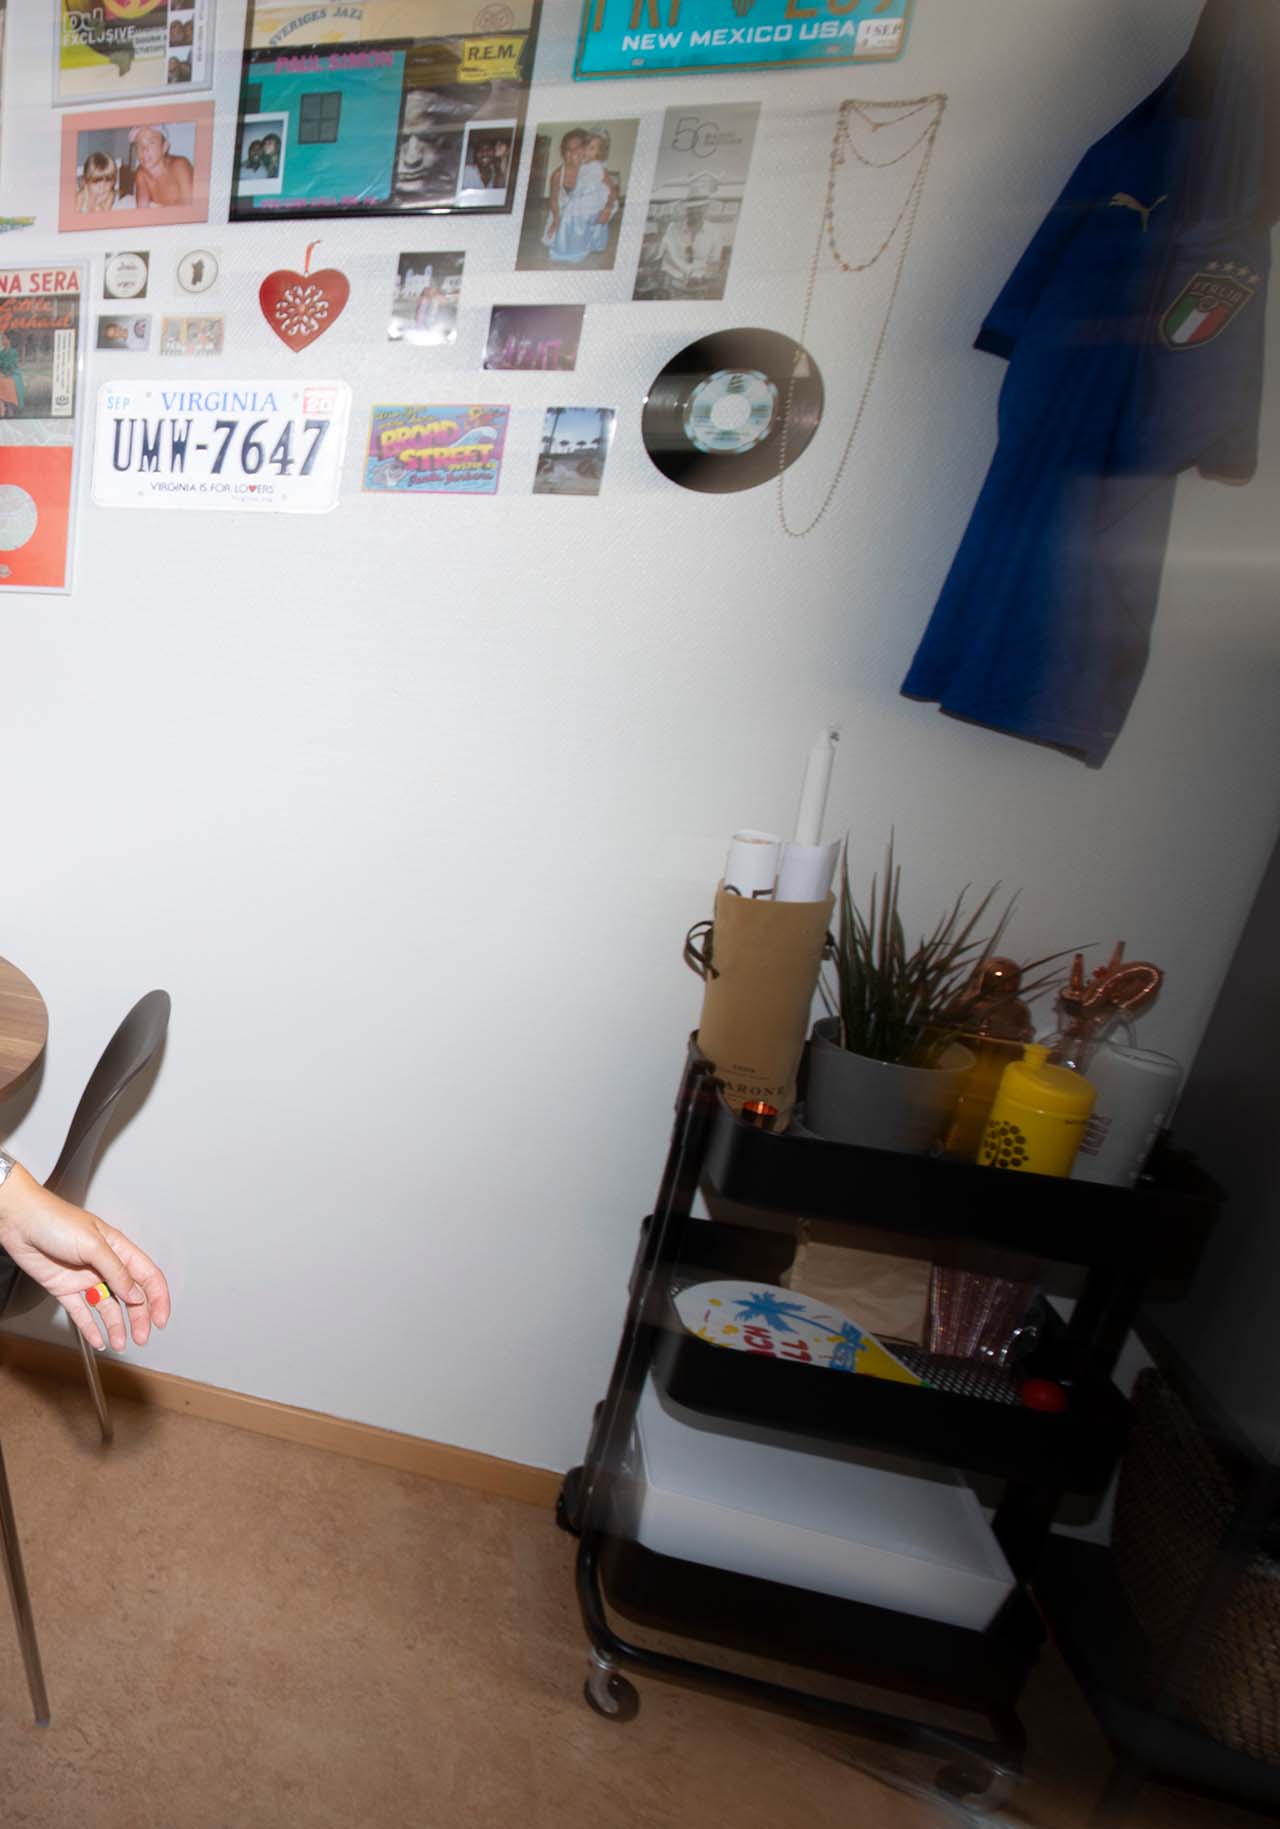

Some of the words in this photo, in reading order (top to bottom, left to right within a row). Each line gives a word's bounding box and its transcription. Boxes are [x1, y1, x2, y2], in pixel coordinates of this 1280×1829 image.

[621, 32, 684, 51] NEW
[689, 24, 793, 48] MEXICO
[798, 19, 856, 41] USA
[467, 43, 517, 61] R.E.M.
[29, 271, 79, 294] SERA
[161, 391, 280, 412] VIRGINIA
[112, 418, 331, 476] UMW-7647
[150, 481, 196, 492] VIRGINIA
[199, 483, 208, 492] IS
[210, 482, 231, 493] FOR
